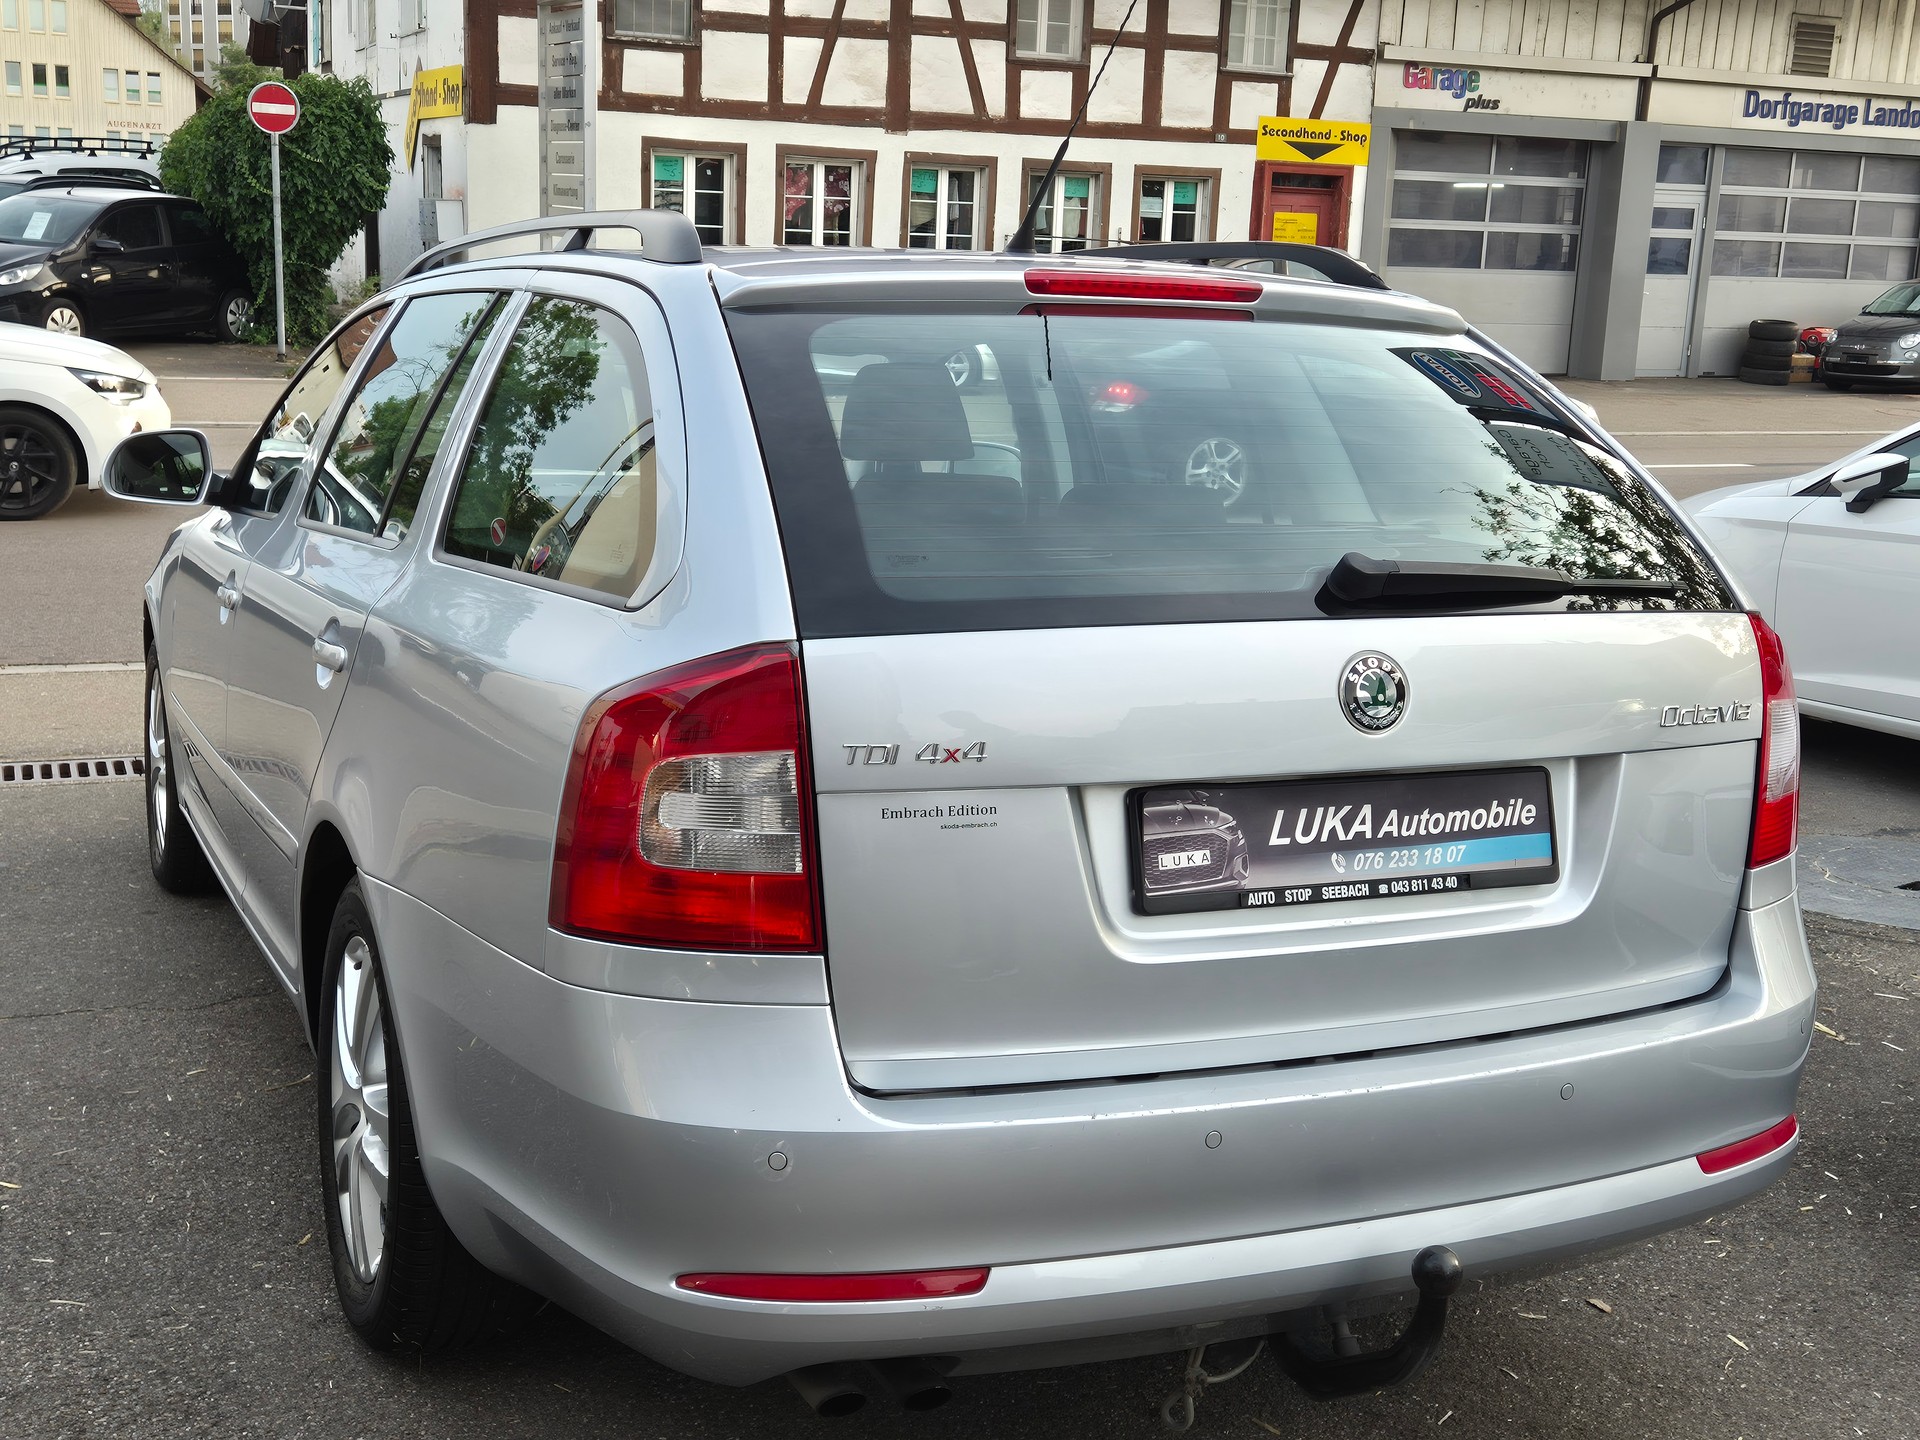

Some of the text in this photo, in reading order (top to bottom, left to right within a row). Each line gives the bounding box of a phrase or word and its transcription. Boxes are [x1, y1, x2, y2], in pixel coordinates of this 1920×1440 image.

[1403, 60, 1480, 99] Garage
[442, 77, 460, 112] Shop
[1463, 93, 1501, 112] plus
[1742, 89, 1859, 130] Dorfgarage
[107, 120, 162, 130] AUGENARZT
[1261, 124, 1332, 141] Secondhand
[1339, 130, 1368, 147] Shop
[1659, 699, 1752, 729] Octavia
[842, 740, 988, 766] TDI 4x4
[880, 803, 998, 820] Embrach Edition
[1269, 798, 1537, 846] LUKA Automobile
[940, 820, 998, 831] skoda-embrach.ch
[1353, 845, 1467, 871] 076 233 18 07
[1248, 876, 1458, 906] AUTO STOP SEEBACH 043 811 43 40
